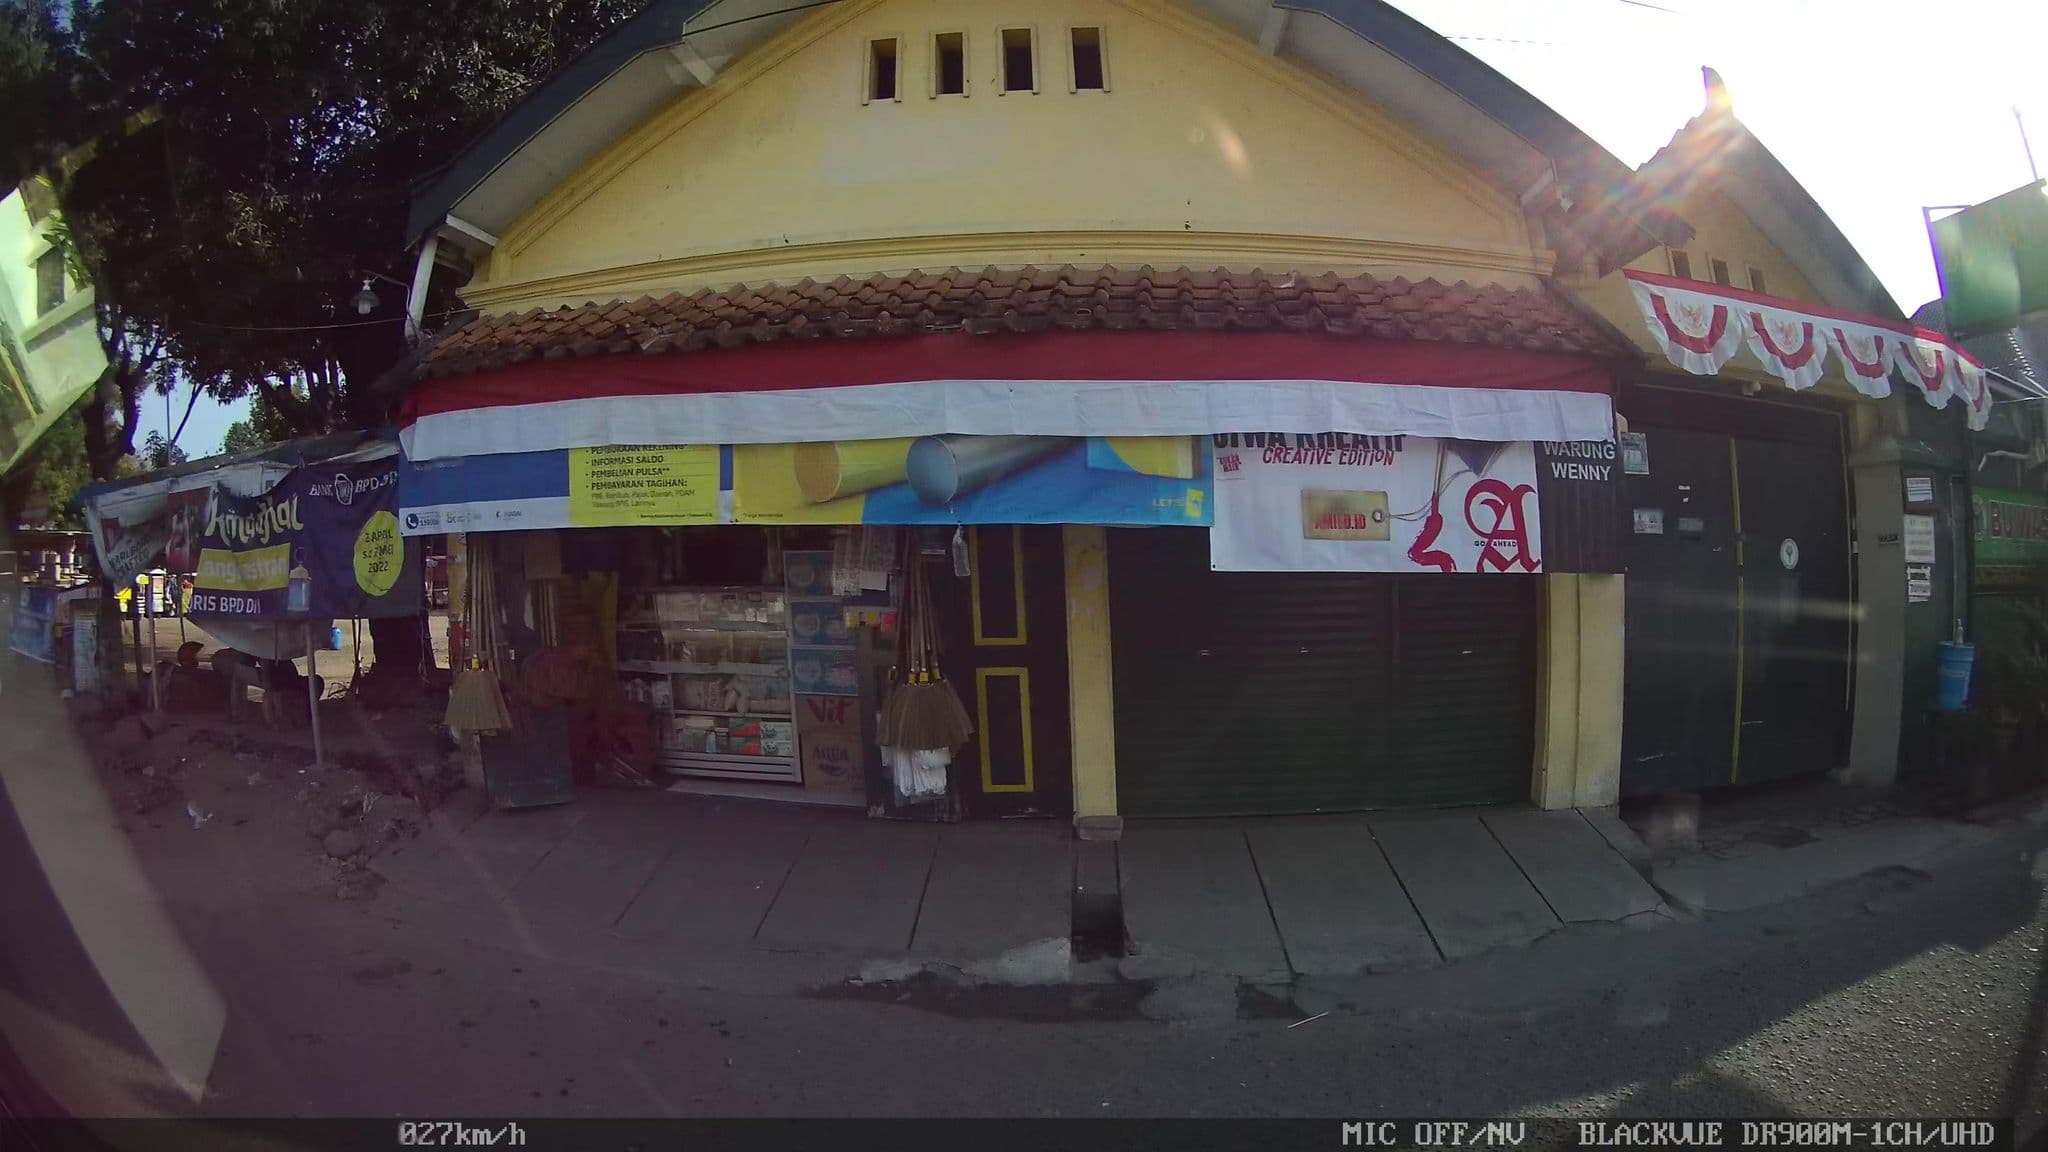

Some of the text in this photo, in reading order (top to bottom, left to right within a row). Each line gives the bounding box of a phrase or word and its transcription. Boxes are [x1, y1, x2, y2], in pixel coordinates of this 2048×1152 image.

[1544, 441, 1615, 460] WARUNG
[591, 455, 664, 466] INFORMASI SALDO
[591, 468, 634, 478] PEMBELIAN
[1552, 462, 1611, 481] WENNY
[309, 482, 331, 498] BANK
[354, 476, 379, 495] BPD
[591, 478, 688, 490] PEMBAYARAN TAGIHAN:
[371, 529, 394, 542] APRIL
[367, 561, 389, 573] 2022
[220, 595, 244, 614] BPD
